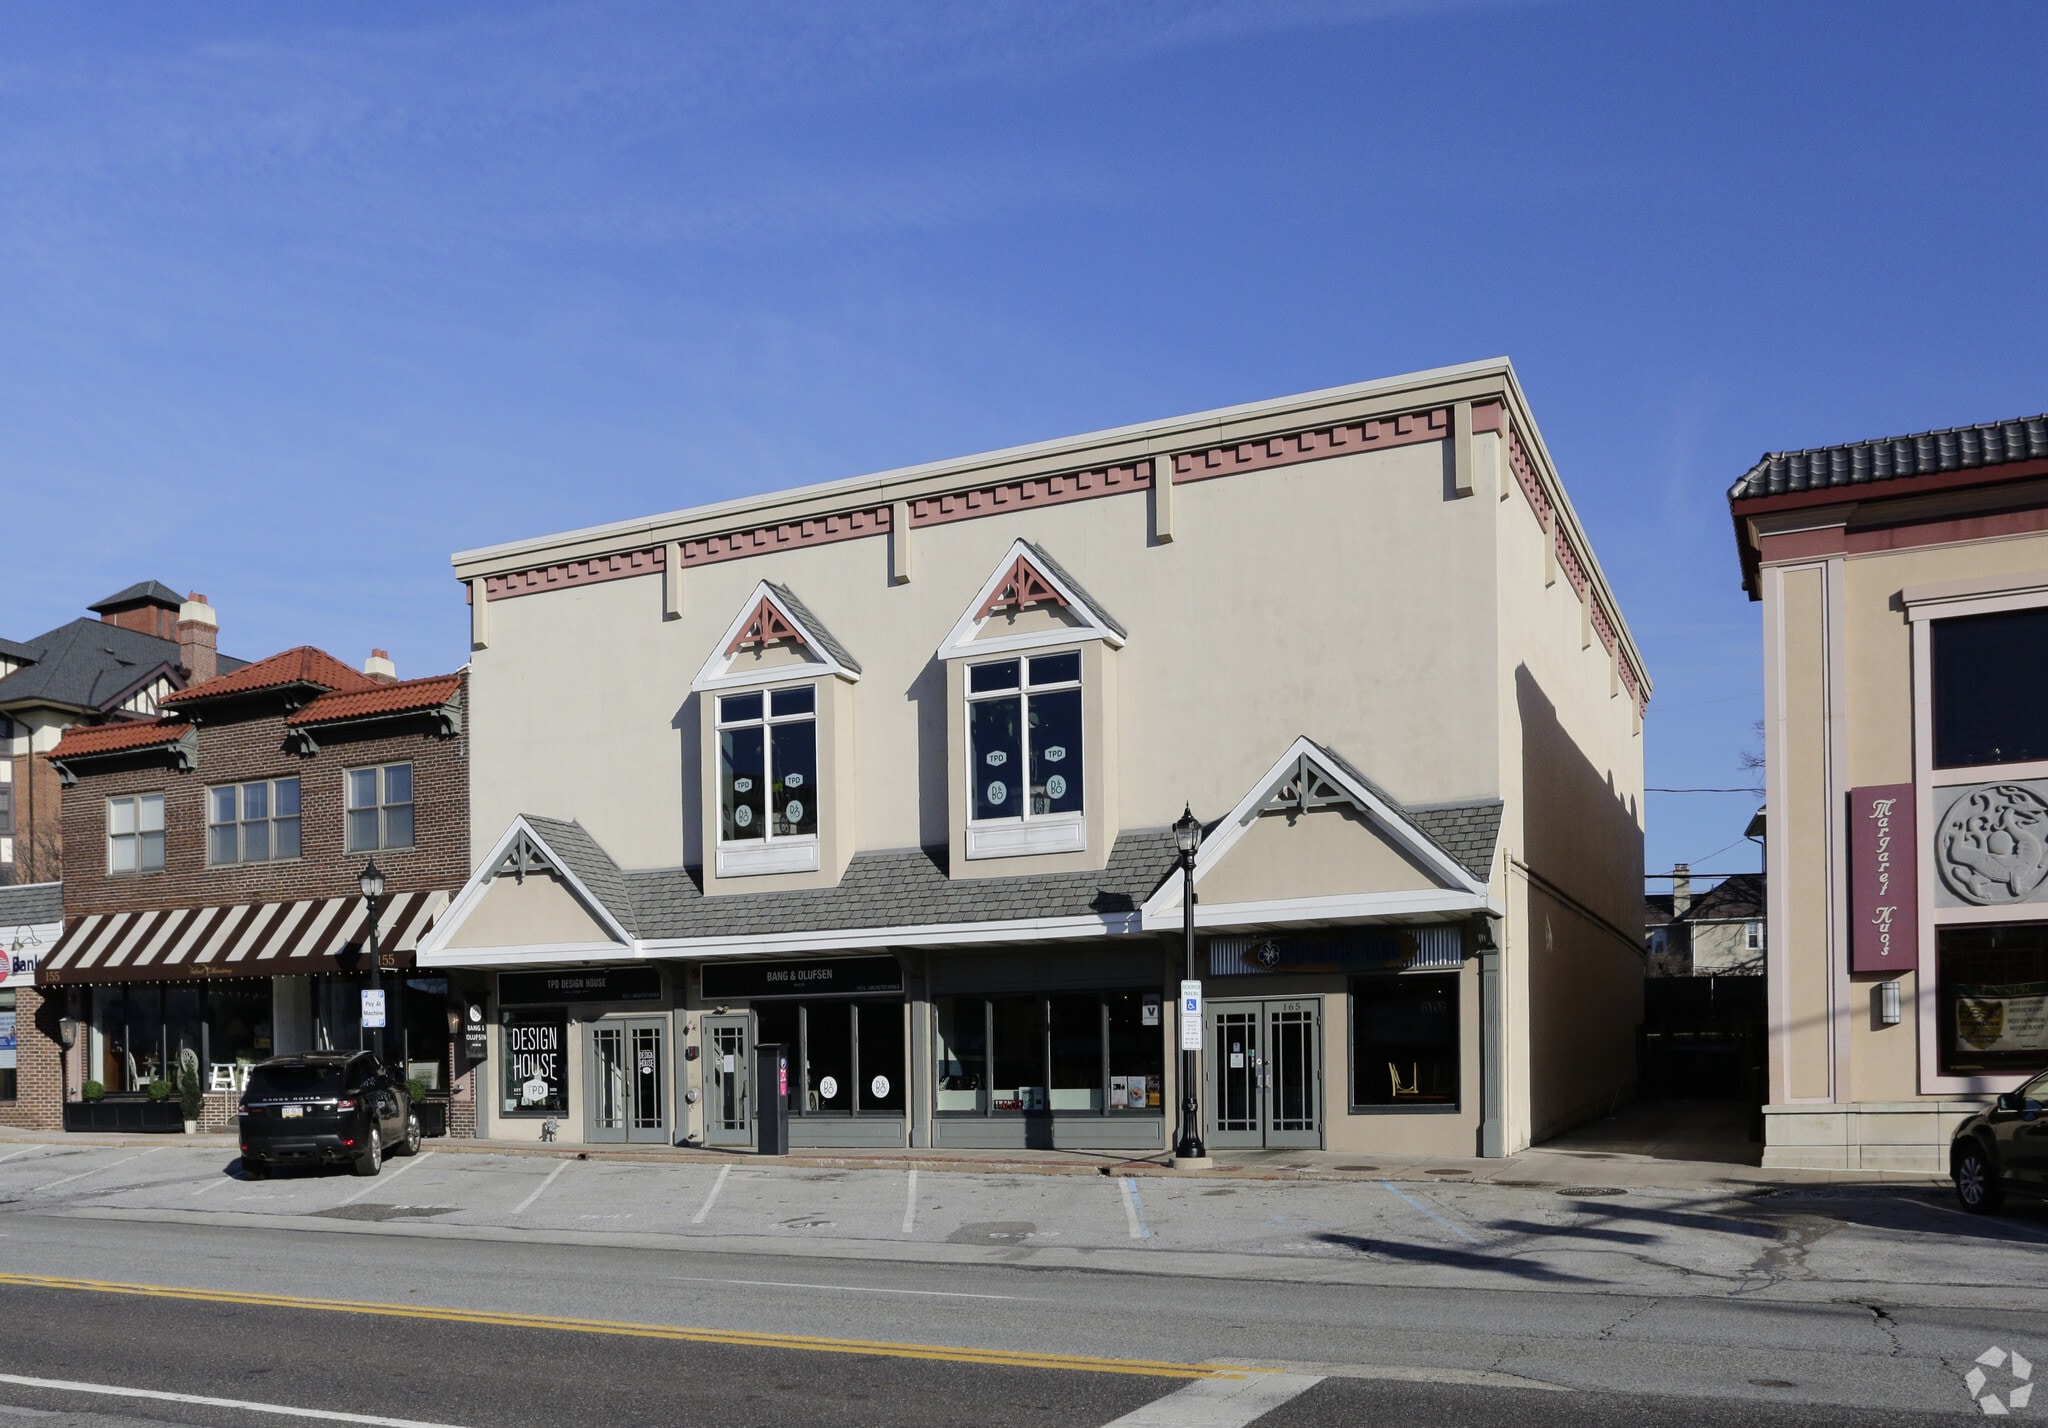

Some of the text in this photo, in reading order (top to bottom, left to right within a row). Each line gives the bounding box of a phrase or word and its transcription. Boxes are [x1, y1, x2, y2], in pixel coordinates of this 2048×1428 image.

[989, 754, 1004, 762] TPD
[1048, 750, 1062, 758] TPD
[1869, 798, 1897, 896] Margaret
[1872, 906, 1897, 956] Kuo's
[378, 954, 395, 966] 155
[46, 971, 61, 982] 155
[767, 969, 833, 982] BANG & OLUFSEN
[561, 979, 583, 989] DESIGN
[585, 977, 607, 988] HOUSE
[1283, 1003, 1301, 1011] 165
[513, 1027, 557, 1051] DESIGN
[513, 1053, 558, 1081] HOUSE
